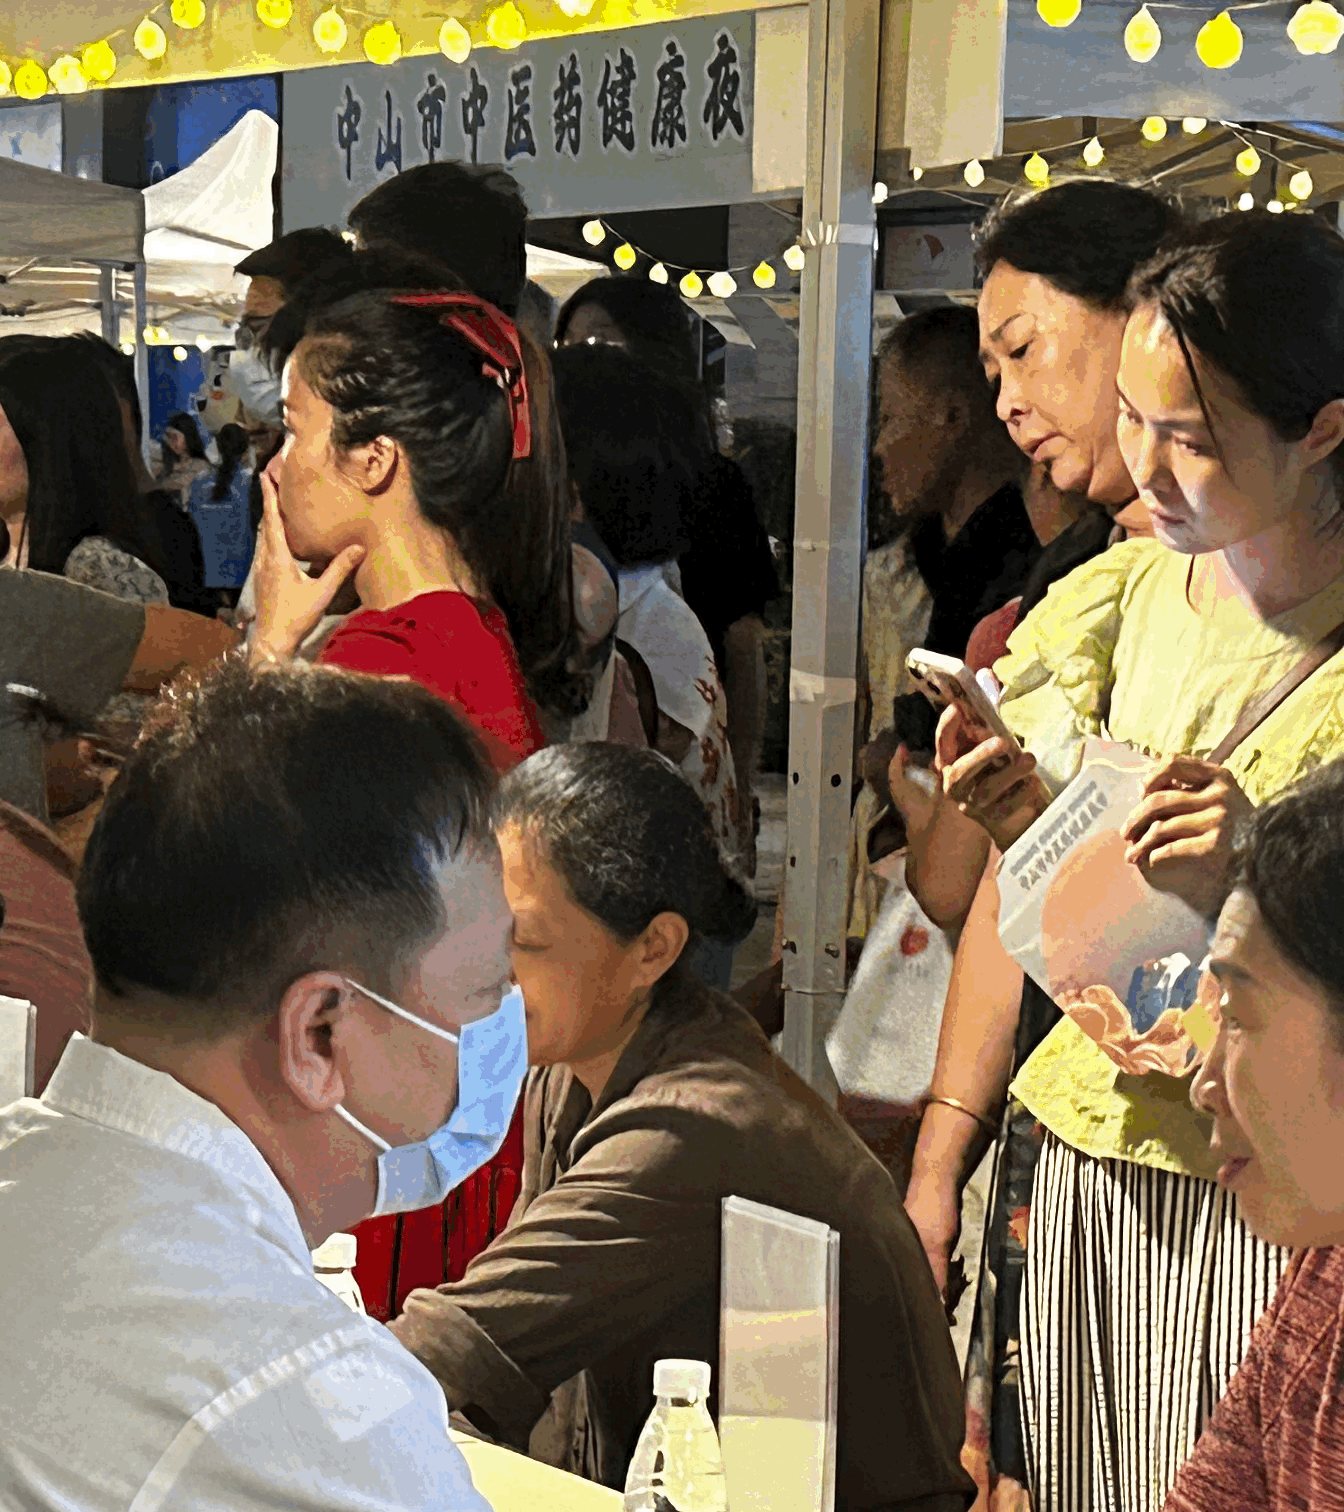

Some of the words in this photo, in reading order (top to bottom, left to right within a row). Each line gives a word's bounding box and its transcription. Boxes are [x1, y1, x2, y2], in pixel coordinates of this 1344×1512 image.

[336, 33, 745, 181] 中山市中医药健康夜
